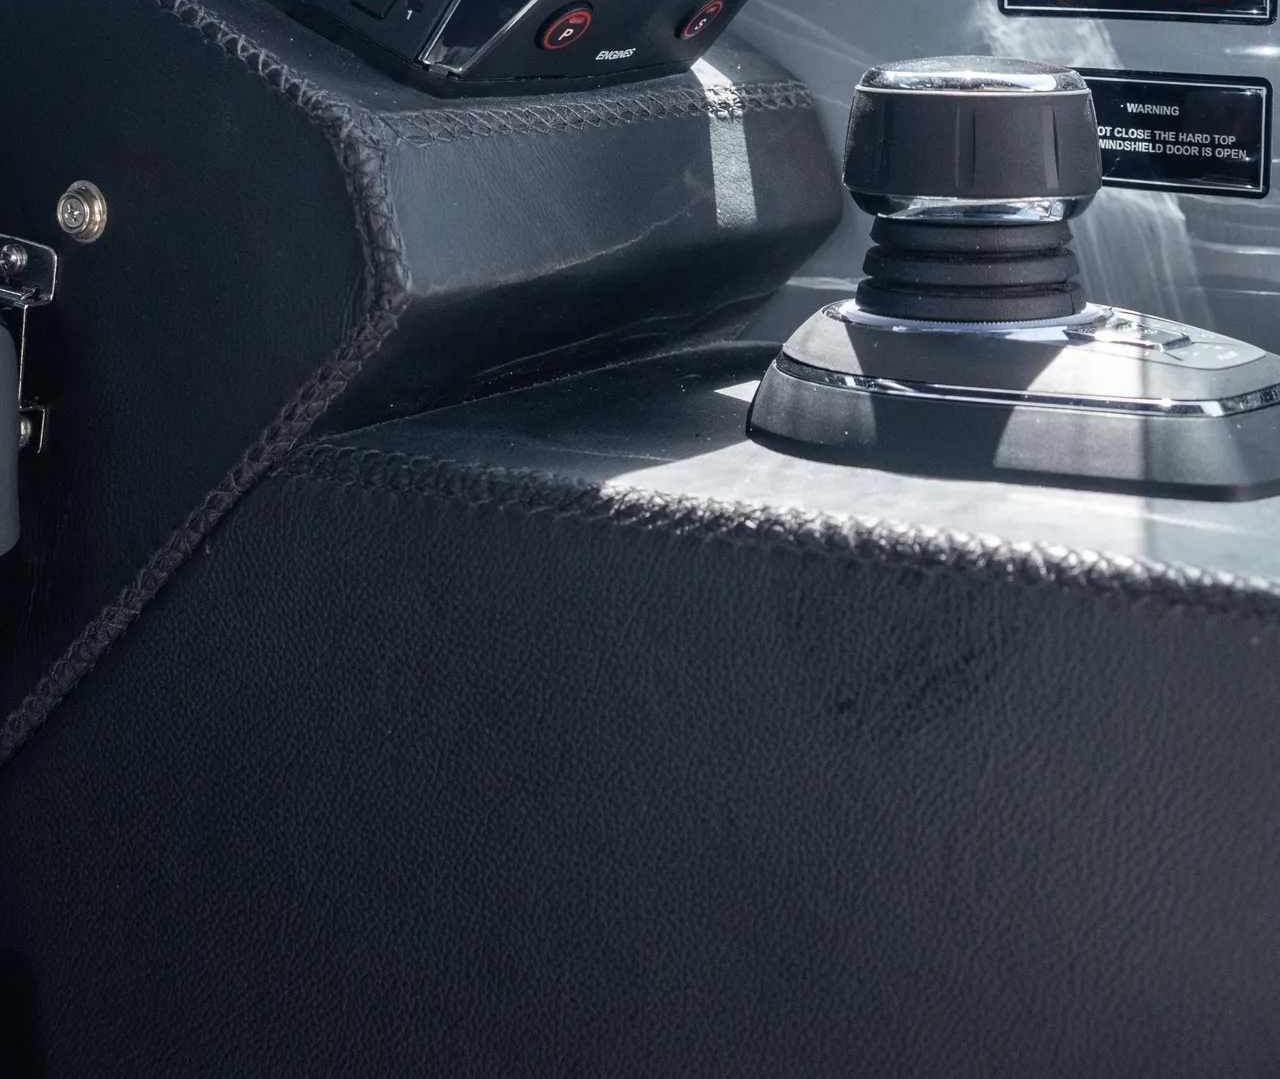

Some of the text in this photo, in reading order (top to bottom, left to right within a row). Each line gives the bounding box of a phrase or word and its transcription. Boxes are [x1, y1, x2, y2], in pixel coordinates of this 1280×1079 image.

[695, 18, 707, 30] S
[558, 29, 574, 40] P
[595, 48, 636, 60] ENGINES
[1127, 103, 1179, 115] WARNING
[1098, 126, 1236, 145] OT CLOSE THE HARD TOP
[1098, 140, 1163, 153] WINDSHIELD
[1167, 144, 1199, 156] DOOR
[1202, 147, 1212, 157] IS
